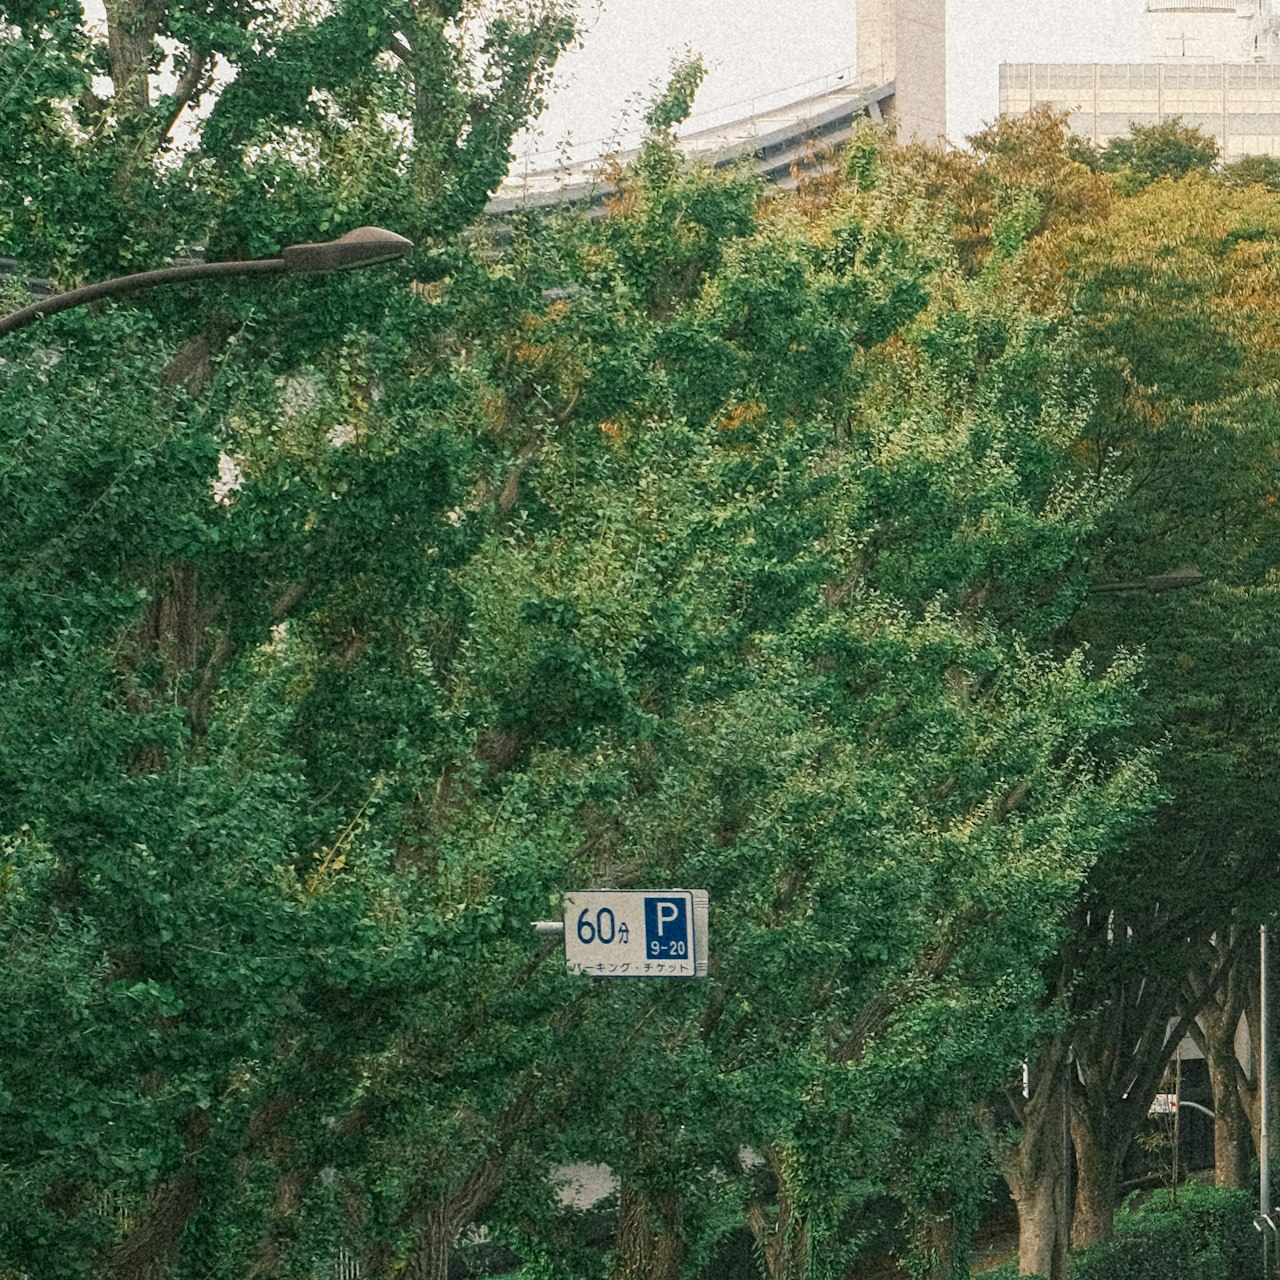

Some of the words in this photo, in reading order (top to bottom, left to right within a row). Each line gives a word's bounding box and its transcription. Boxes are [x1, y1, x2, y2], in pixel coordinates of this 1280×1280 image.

[577, 907, 630, 944] 60分
[657, 902, 679, 937] P
[651, 941, 686, 956] 9-20
